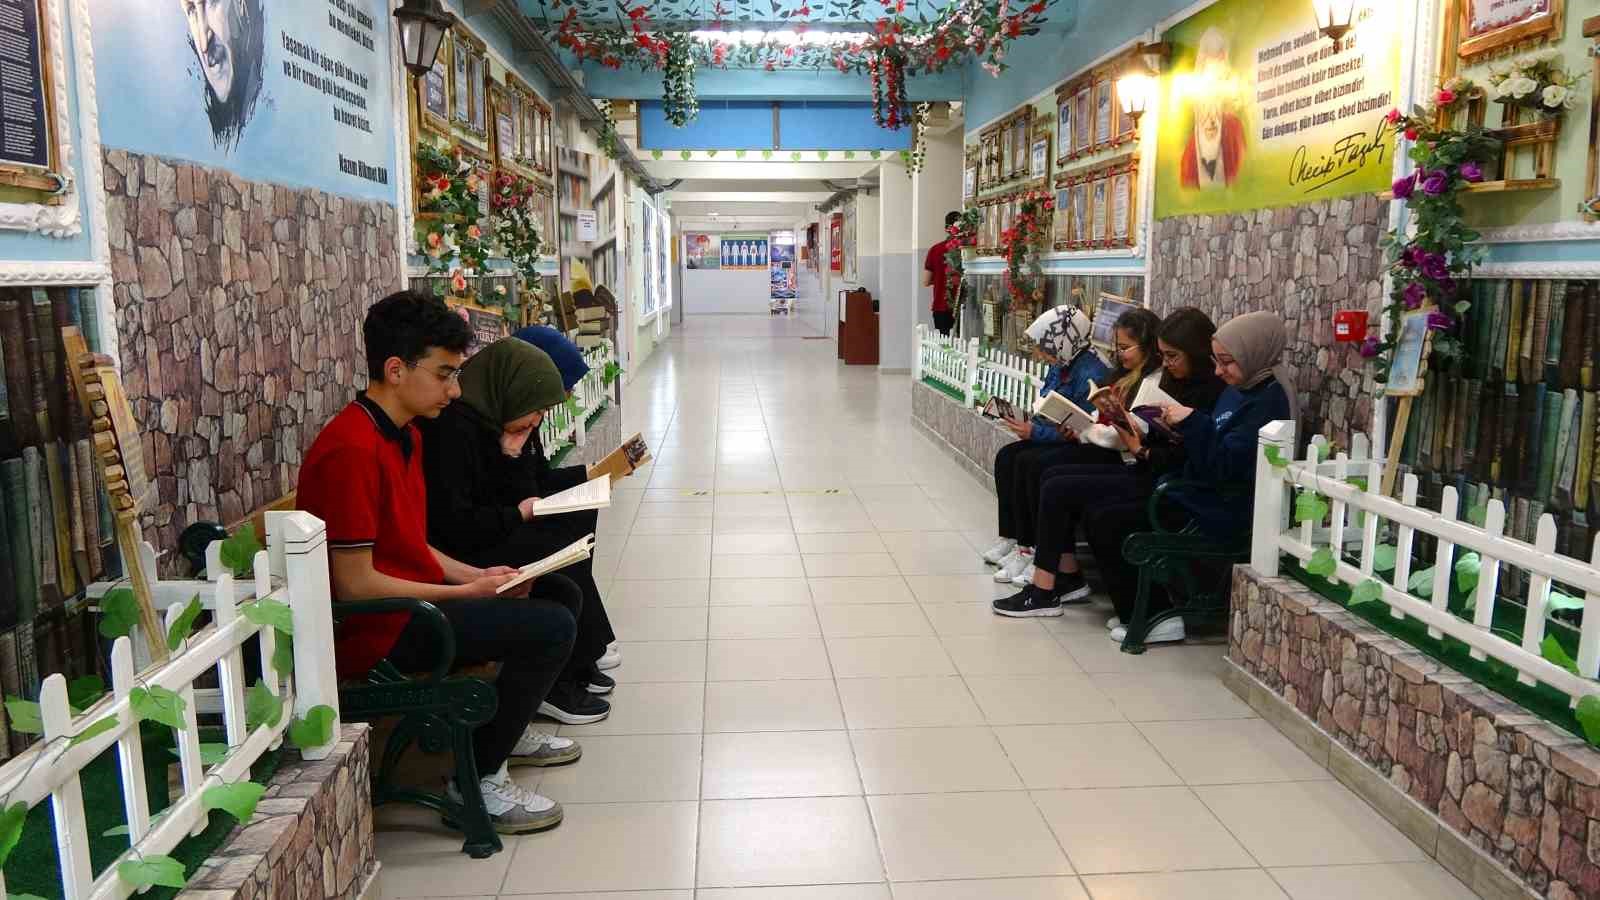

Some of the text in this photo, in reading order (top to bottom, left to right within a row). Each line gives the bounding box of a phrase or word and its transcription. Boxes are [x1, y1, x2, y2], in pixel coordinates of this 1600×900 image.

[281, 29, 311, 61] Yaşamak
[311, 46, 320, 66] bir
[320, 53, 335, 76] ağaç
[335, 60, 345, 78] gibi
[1306, 51, 1319, 66] eve
[283, 60, 292, 76] ve
[292, 61, 302, 81] bir
[302, 69, 322, 91] orman
[322, 78, 333, 97] gibi
[1315, 88, 1332, 104] elbet
[1333, 77, 1365, 99] bizimdir!
[1300, 115, 1312, 132] gün
[1338, 100, 1356, 119] ebed
[1357, 90, 1392, 114] bizimdir!
